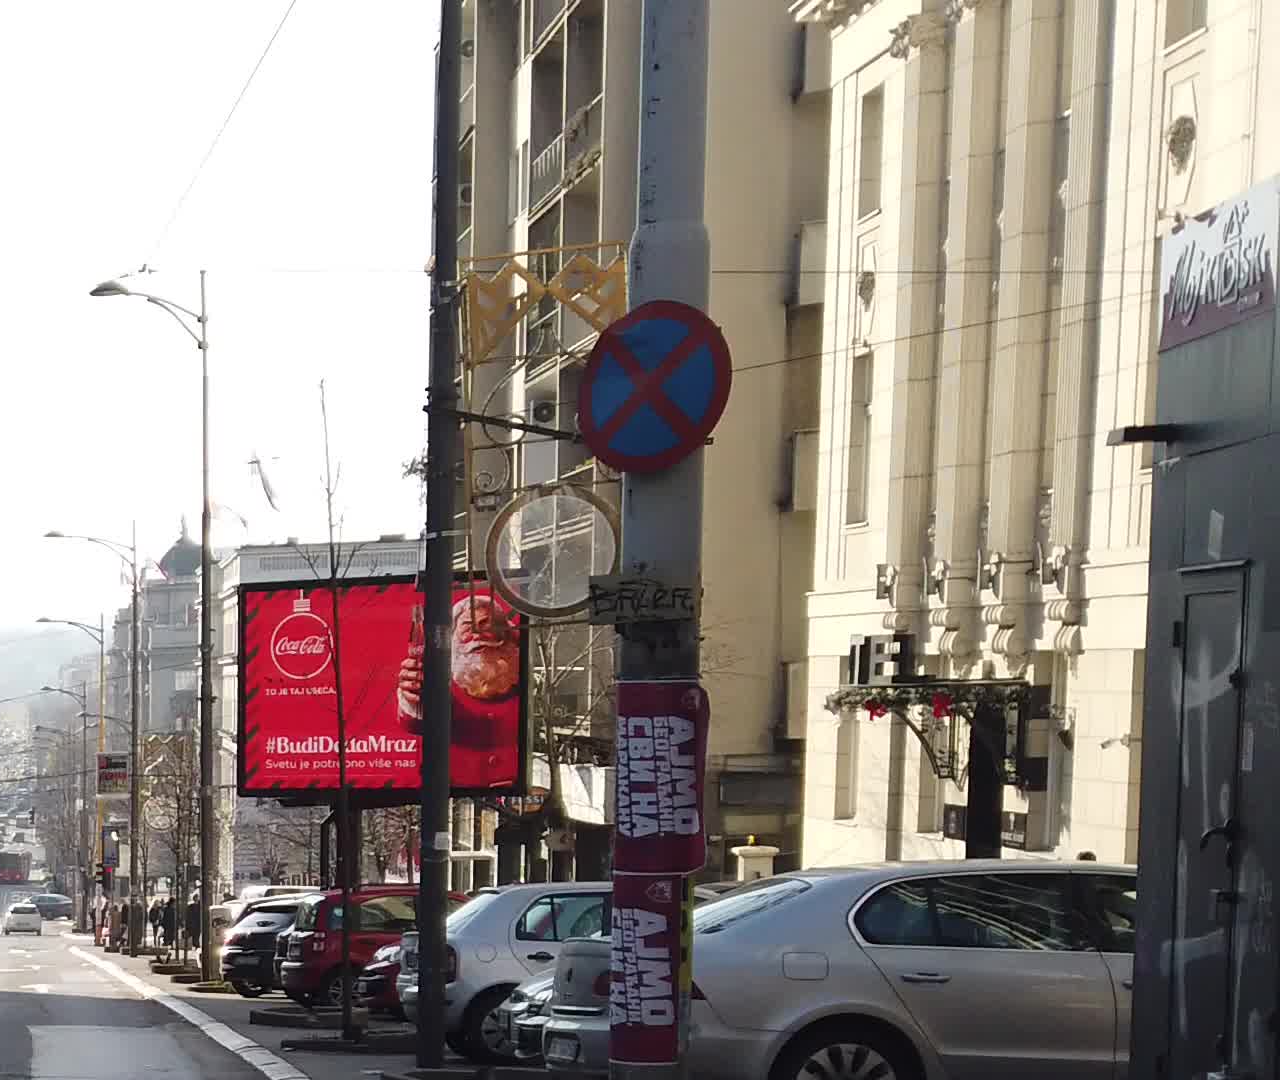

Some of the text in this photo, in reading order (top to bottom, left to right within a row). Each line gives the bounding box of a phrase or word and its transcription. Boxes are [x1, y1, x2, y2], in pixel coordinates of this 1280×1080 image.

[265, 759, 297, 769] Svetu
[299, 759, 311, 770] je
[369, 757, 392, 769] više
[394, 759, 417, 768] nas
[627, 716, 659, 838] СВИ НА
[668, 715, 700, 835] АЈМО
[634, 908, 676, 1026] АЈМО
